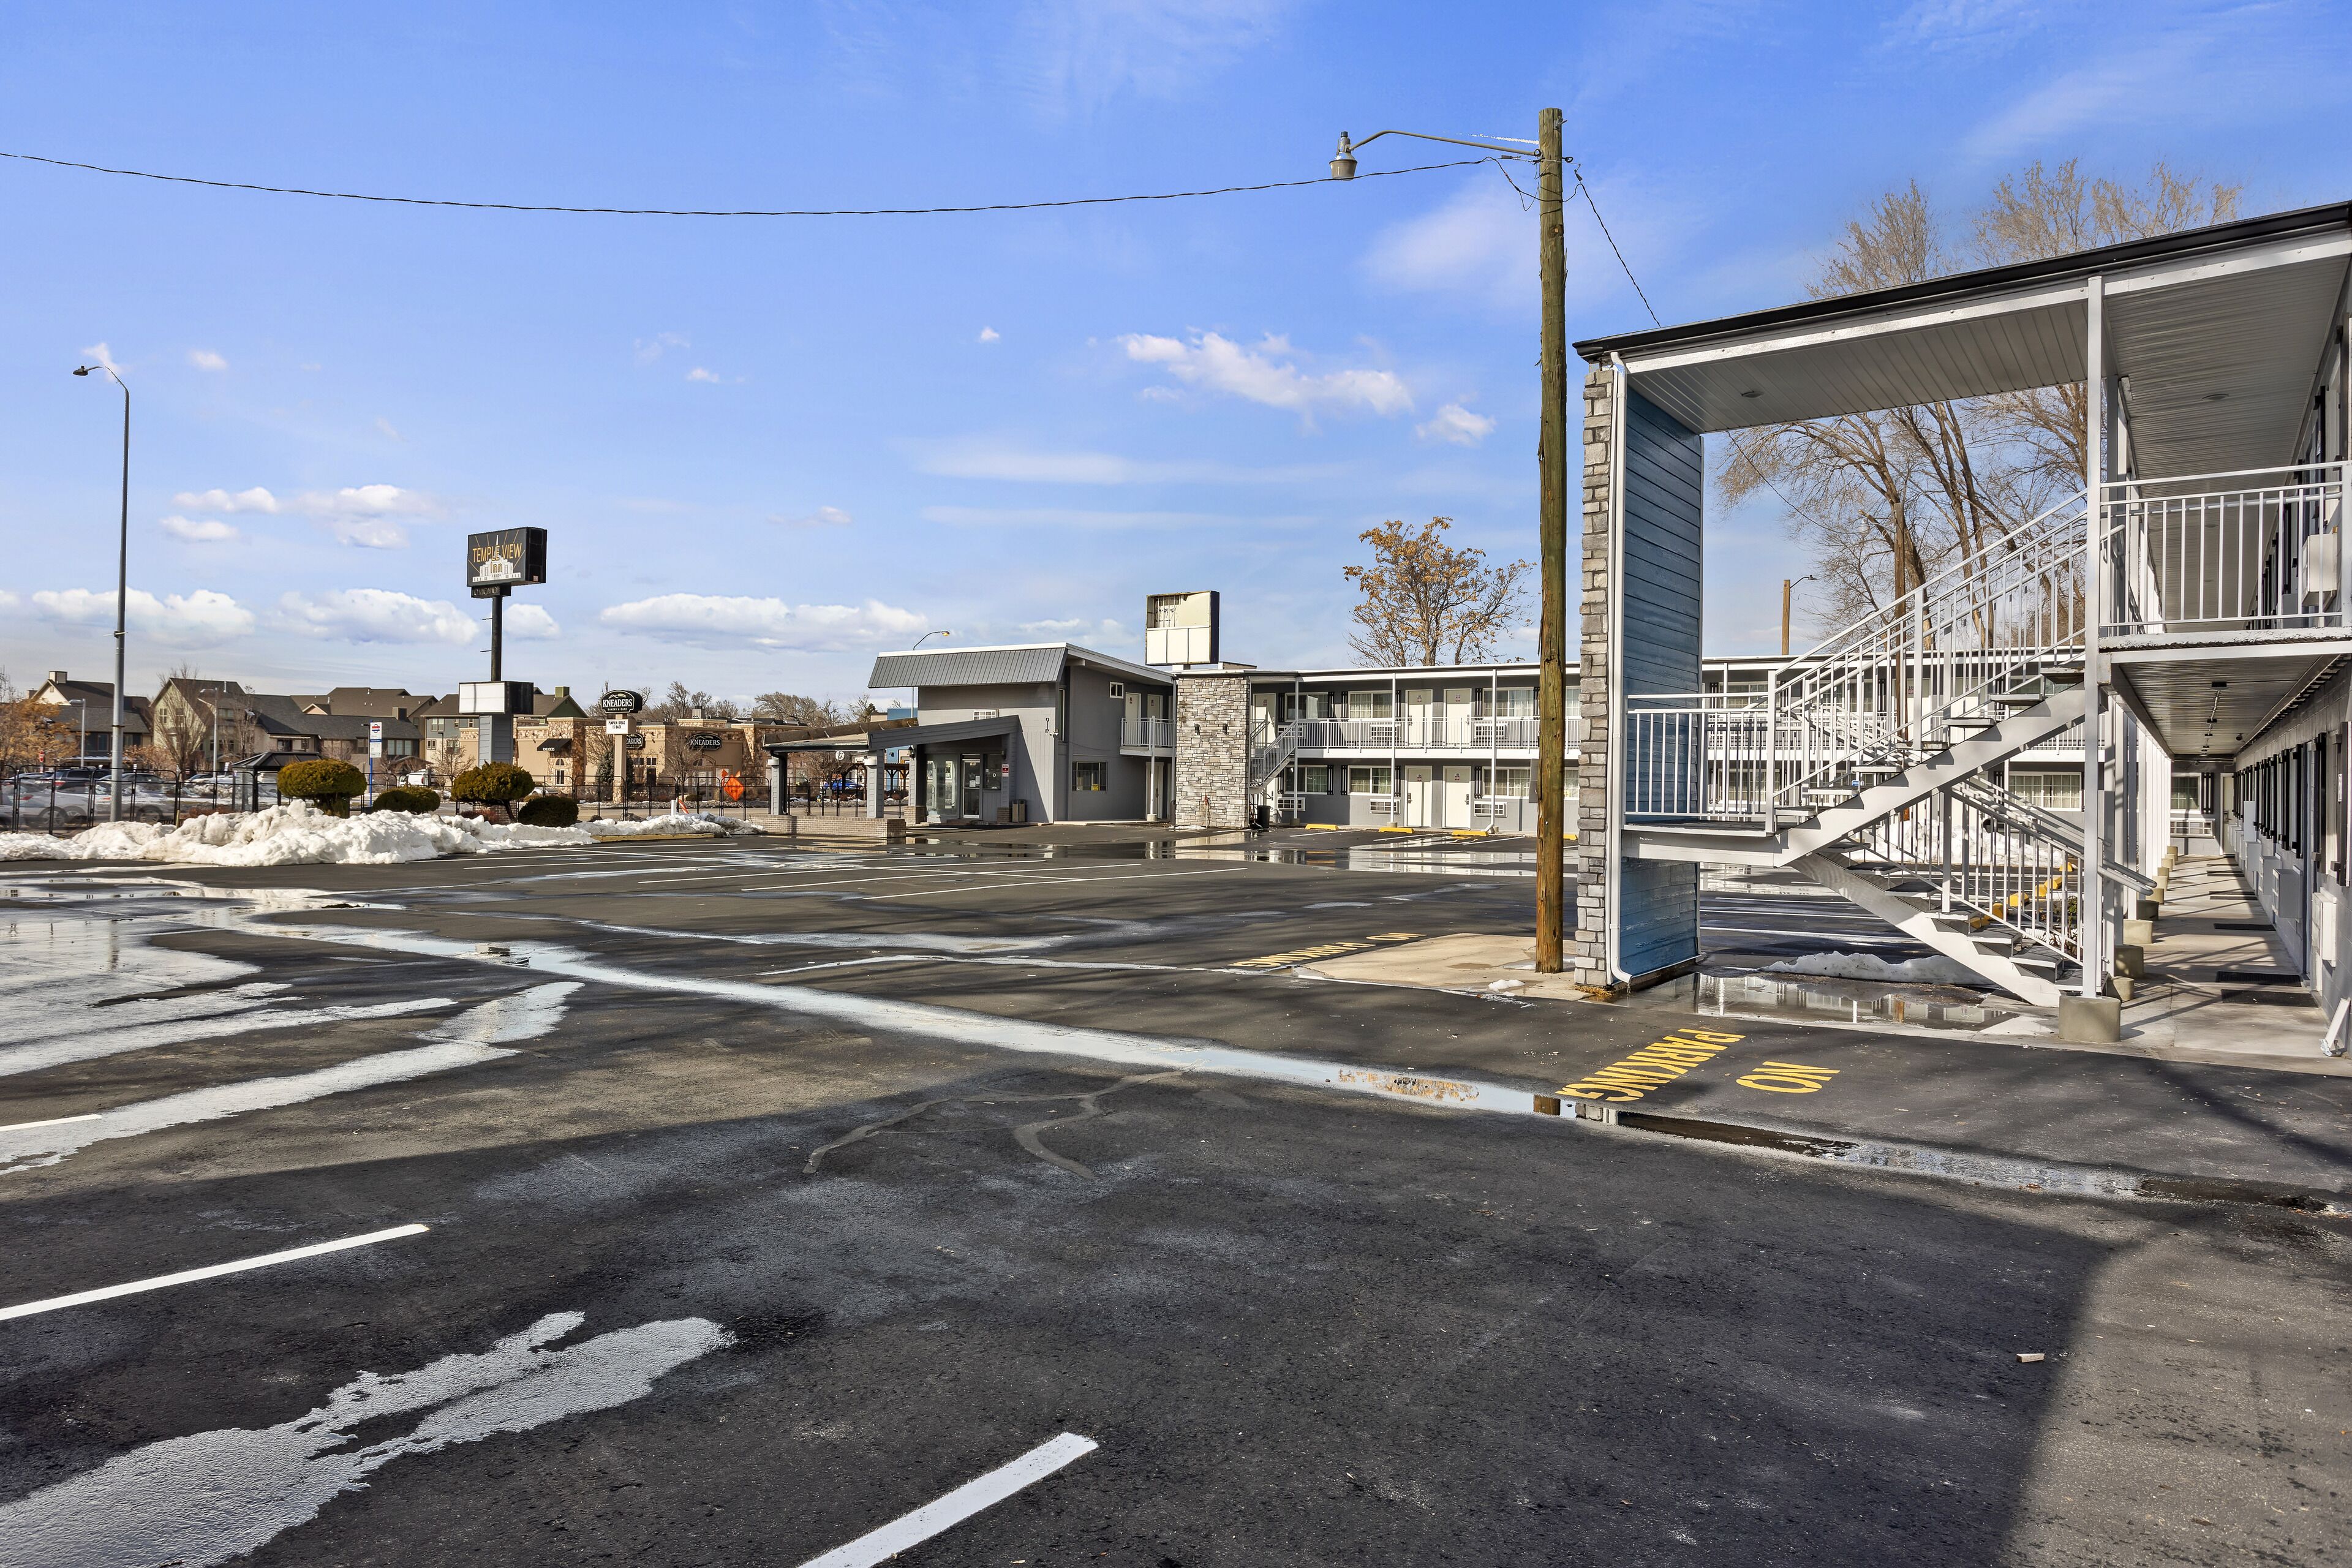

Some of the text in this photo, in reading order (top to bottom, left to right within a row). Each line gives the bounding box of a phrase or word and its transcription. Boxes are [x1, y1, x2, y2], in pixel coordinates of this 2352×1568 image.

[472, 543, 522, 563] TEMPLE VIEW
[490, 562, 502, 573] Inn
[1227, 932, 1427, 967] NO PARKING
[1555, 1028, 1746, 1102] PARKING
[1736, 1061, 1841, 1094] NO
